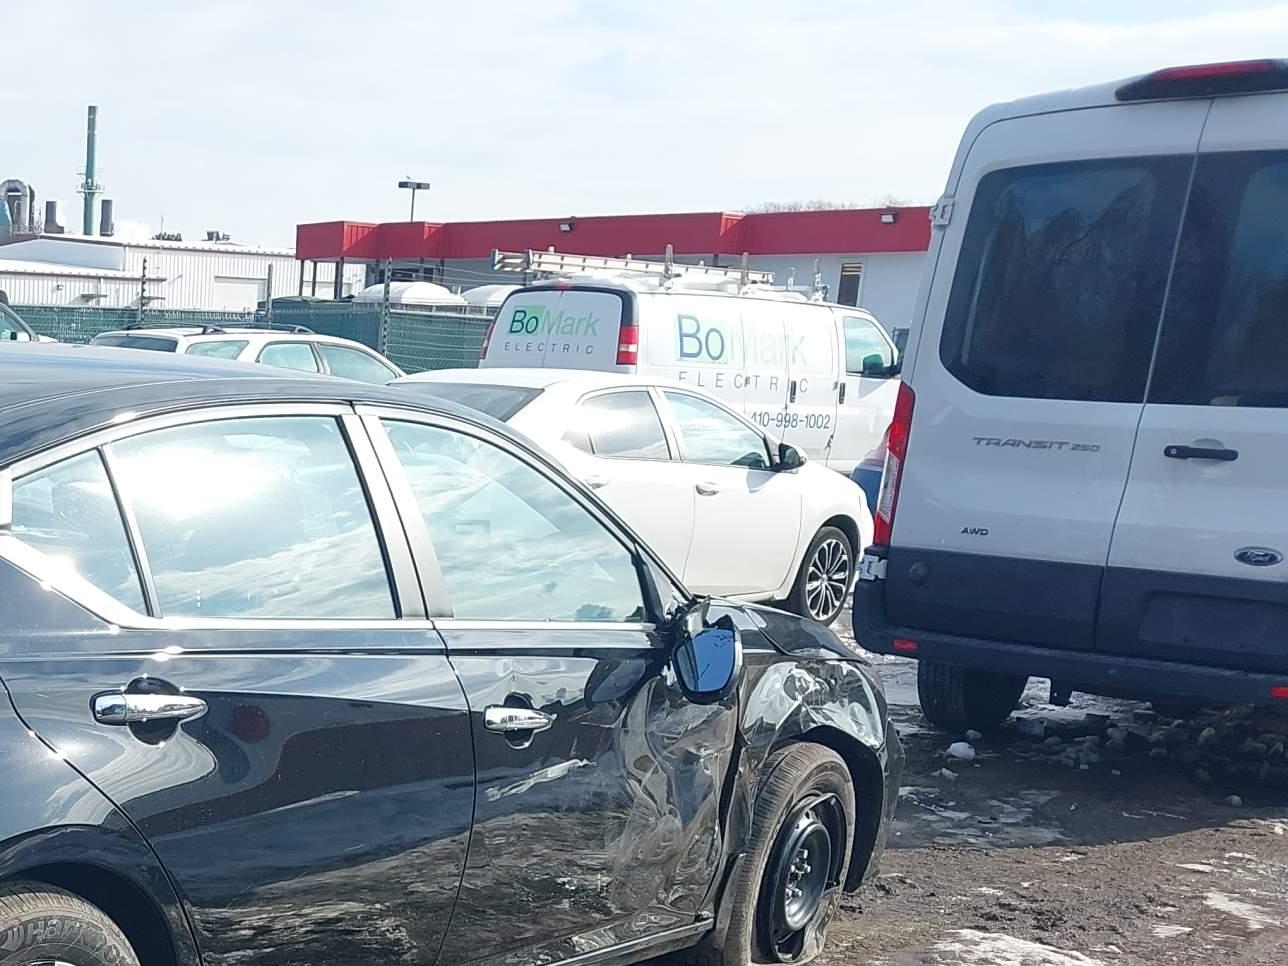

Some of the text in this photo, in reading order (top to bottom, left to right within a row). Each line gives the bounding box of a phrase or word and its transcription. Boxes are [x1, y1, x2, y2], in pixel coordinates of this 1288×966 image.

[509, 309, 600, 337] BoMark
[504, 341, 594, 355] ELECTRIC
[972, 437, 1101, 452] TRANSIT 250
[961, 527, 989, 536] AWD
